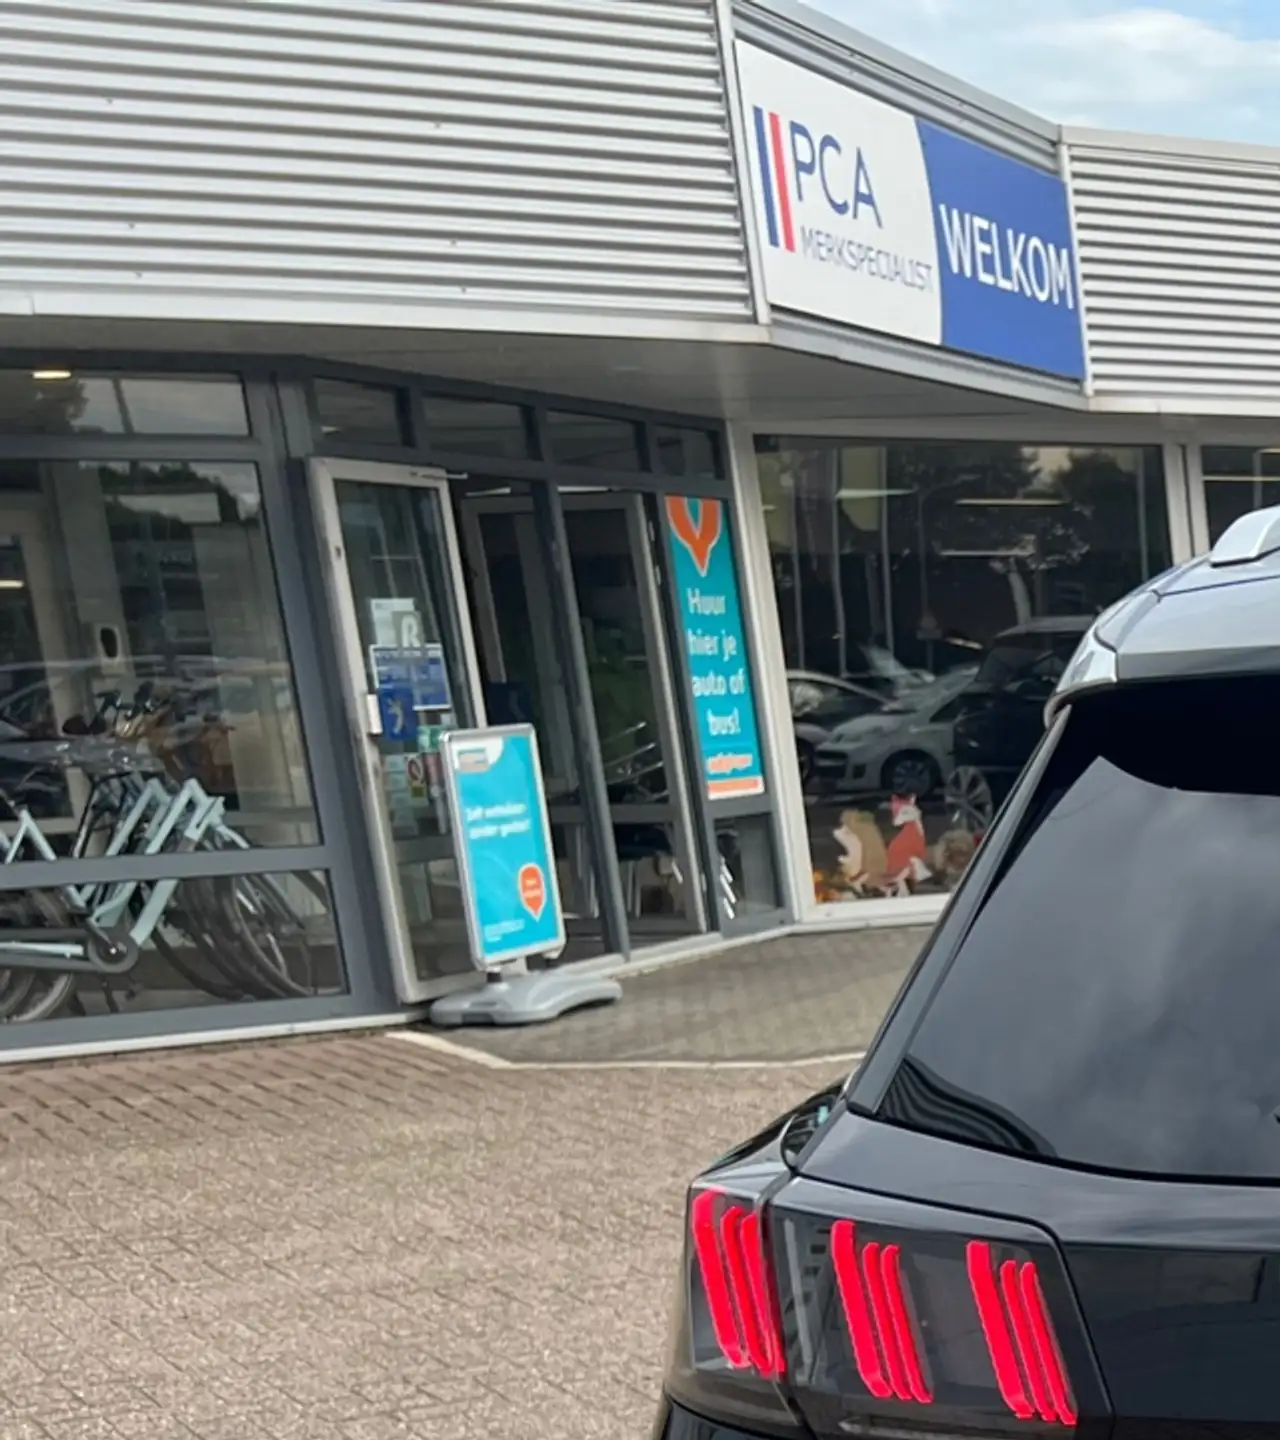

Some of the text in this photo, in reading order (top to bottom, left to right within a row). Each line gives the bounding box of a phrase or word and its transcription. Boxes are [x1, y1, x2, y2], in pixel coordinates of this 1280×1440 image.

[790, 119, 884, 229] PCA
[800, 225, 934, 293] MERKSPECIALIST
[938, 203, 1075, 310] WELKOM
[686, 587, 726, 615] Huur
[686, 628, 738, 662] hier je
[691, 667, 746, 698] auto of
